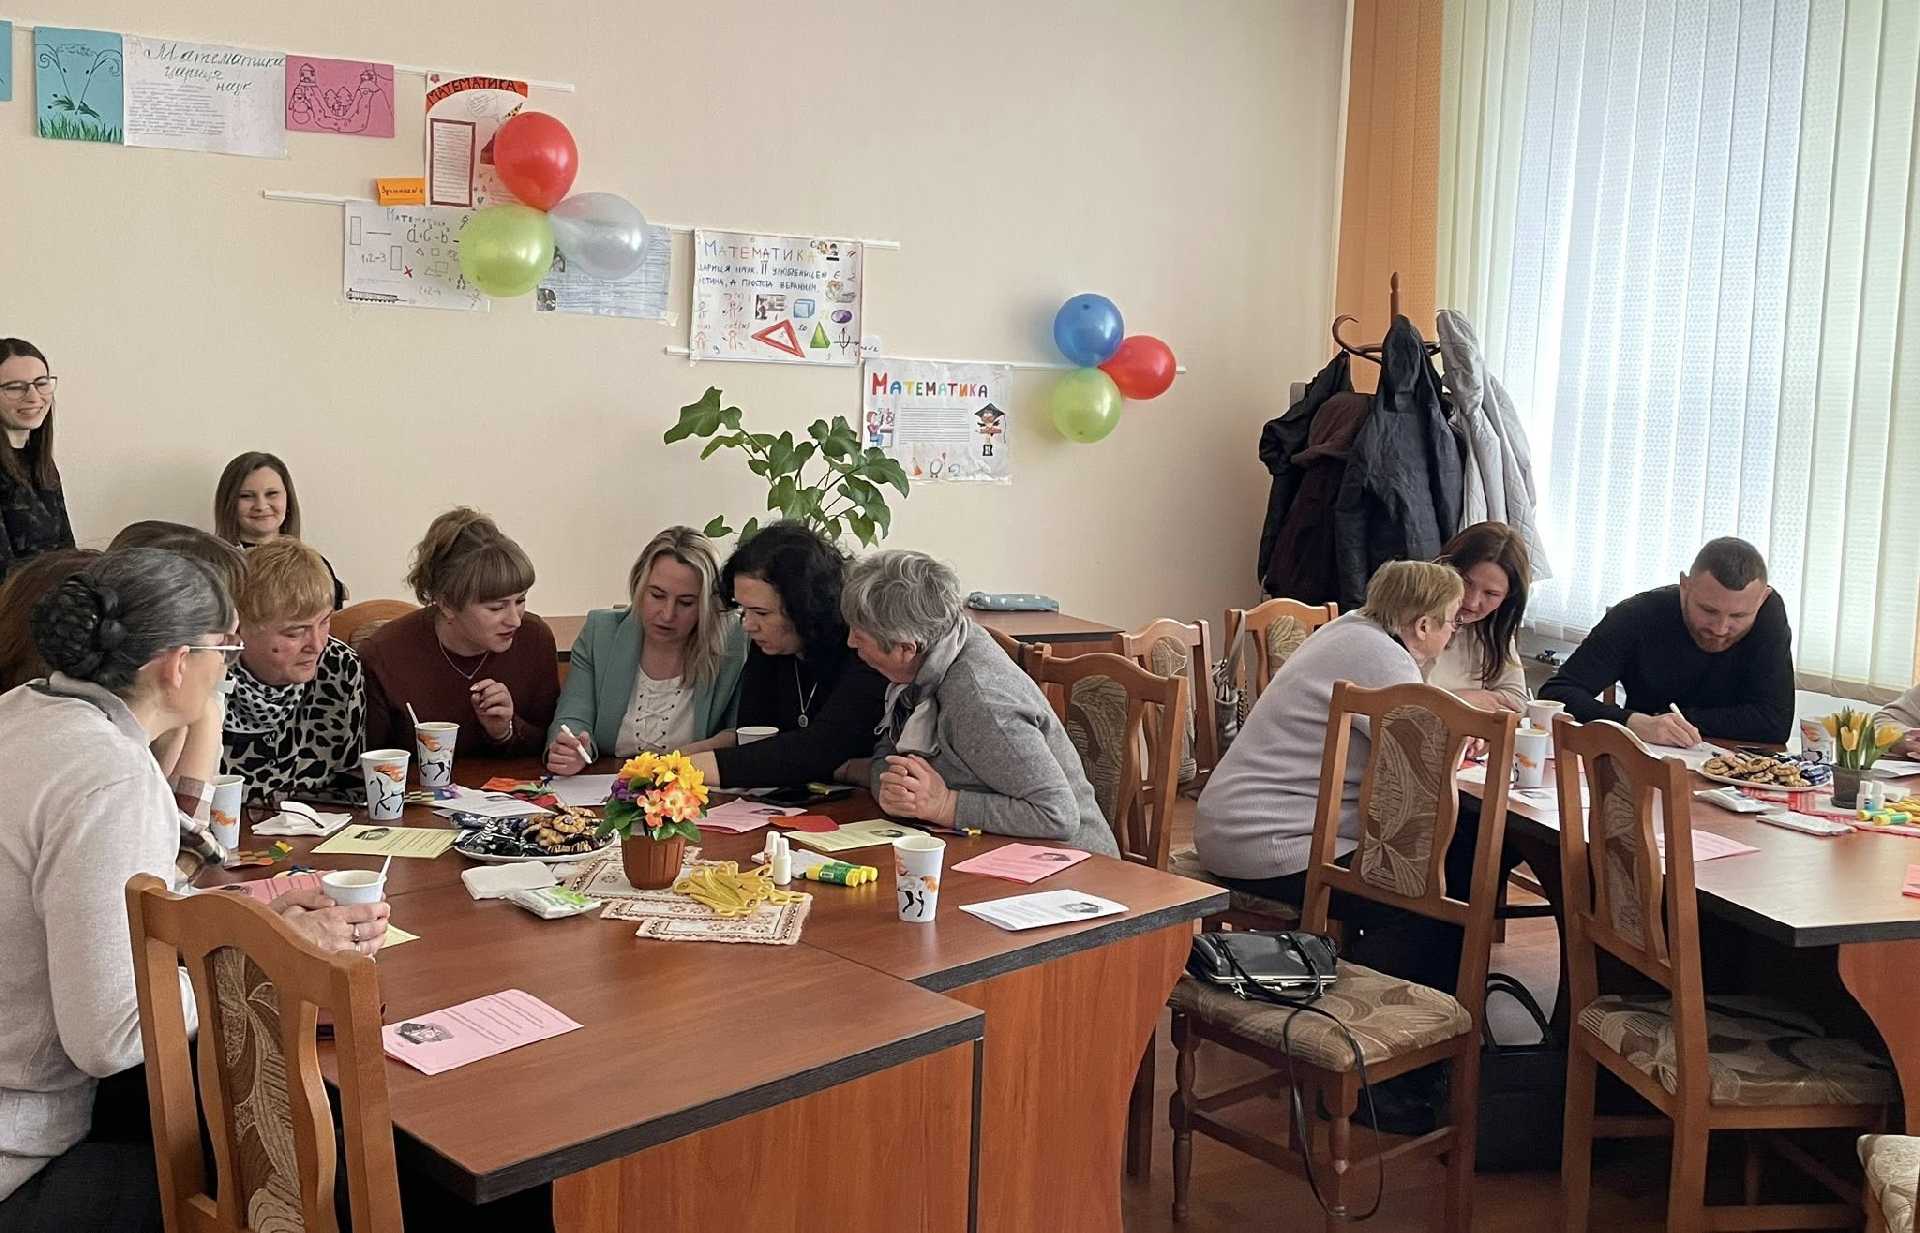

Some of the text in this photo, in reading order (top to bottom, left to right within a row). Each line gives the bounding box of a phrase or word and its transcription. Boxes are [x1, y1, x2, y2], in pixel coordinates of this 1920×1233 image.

[426, 76, 517, 106] МАТЕМАТИКА
[704, 239, 816, 264] МАТЕМАТИКА
[871, 372, 988, 398] МАТЕМАТИКА
